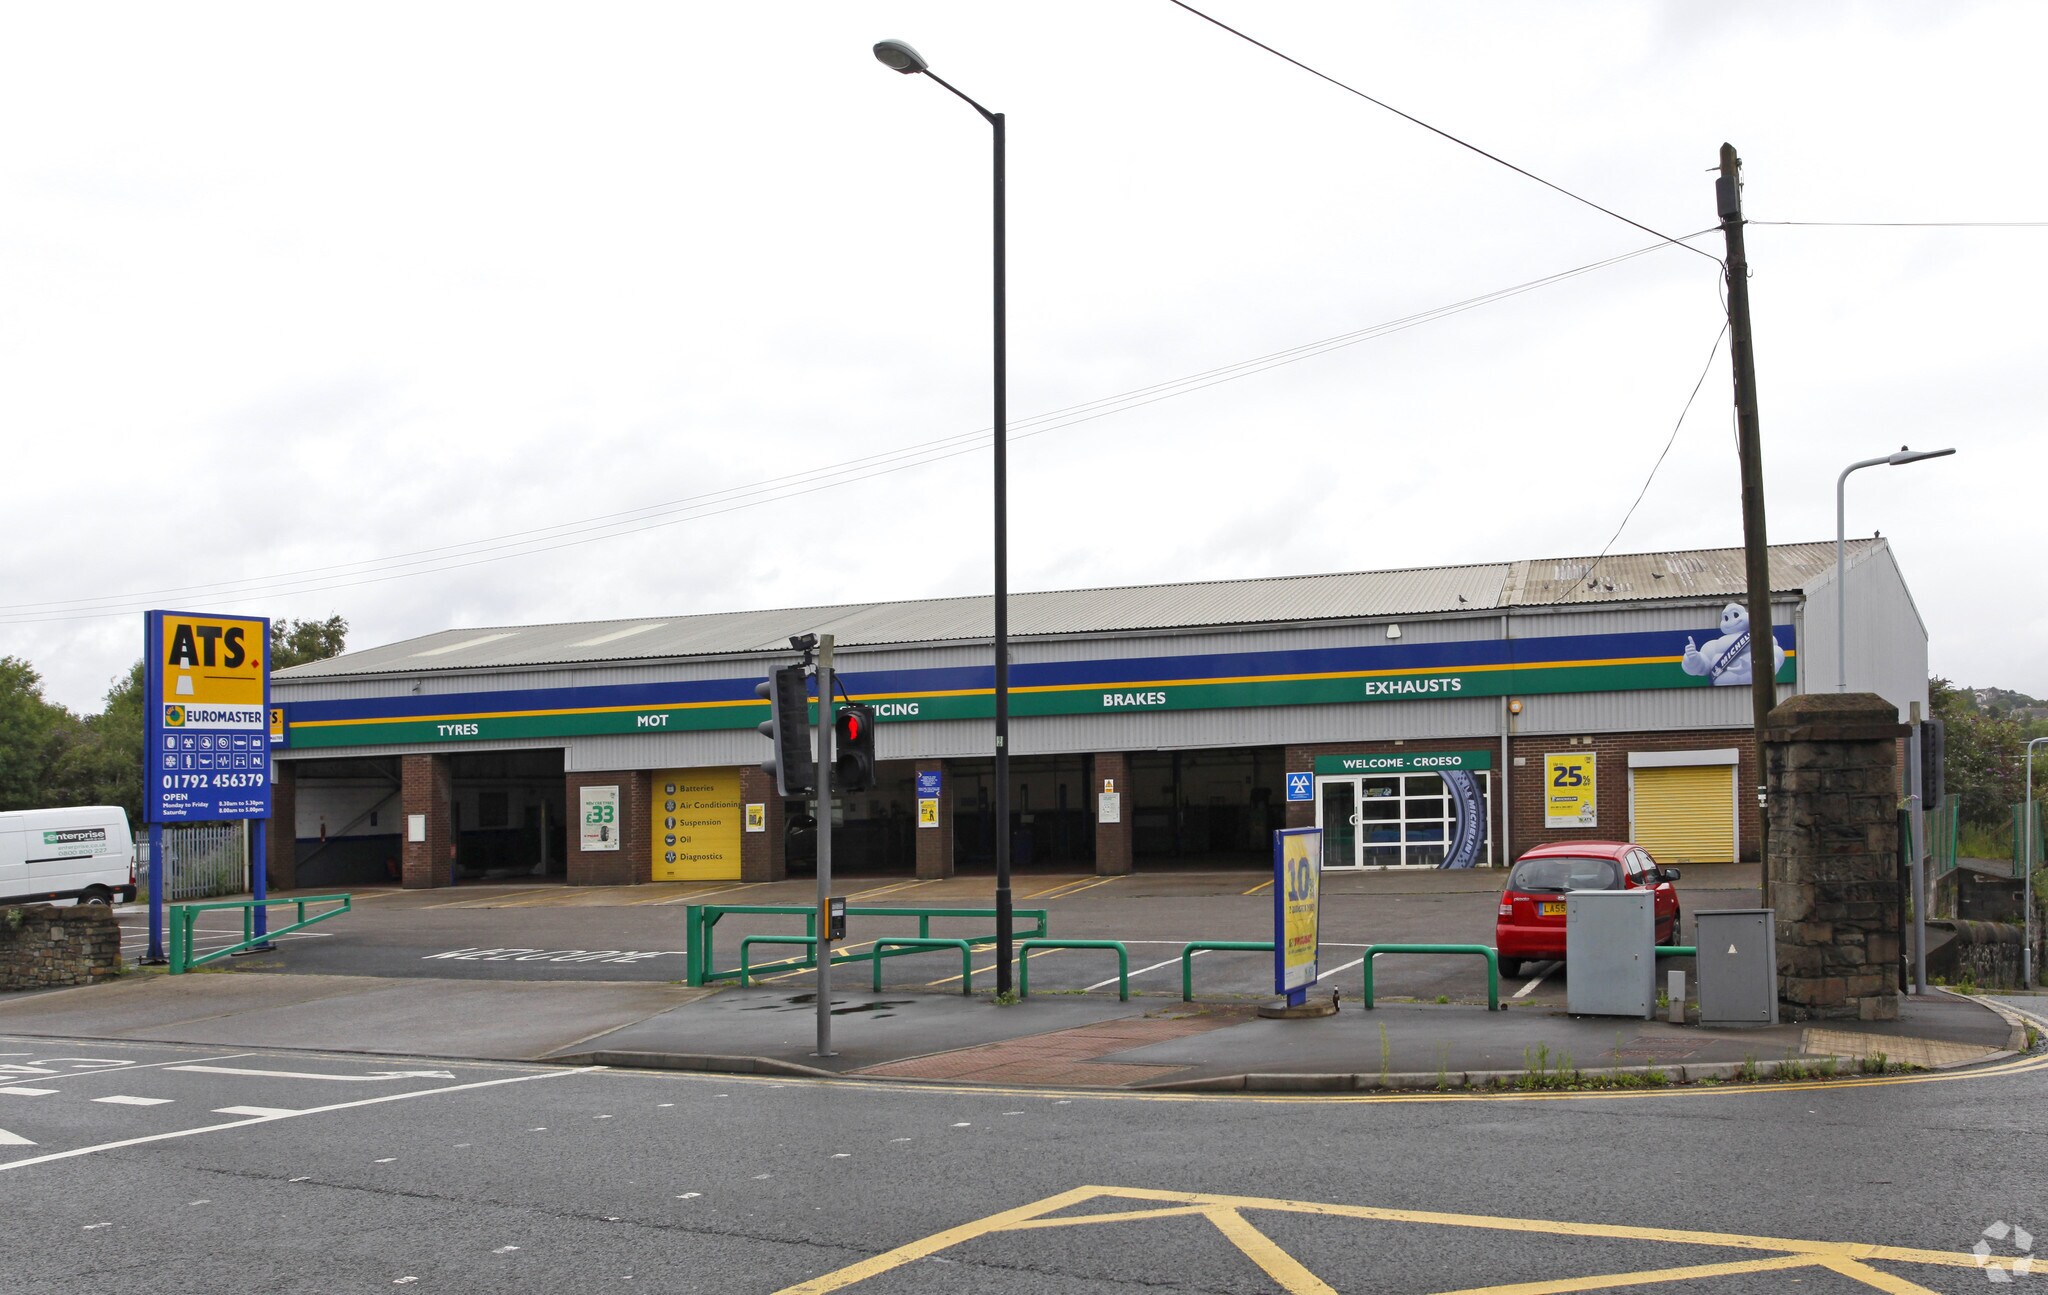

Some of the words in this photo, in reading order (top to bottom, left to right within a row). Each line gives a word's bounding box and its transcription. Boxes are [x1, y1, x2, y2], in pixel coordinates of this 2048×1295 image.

[1720, 632, 1751, 667] MICHEL
[1365, 678, 1462, 695] EXHAUSTS
[1103, 691, 1166, 707] BRAKES
[186, 710, 262, 723] EUROMASTER
[637, 714, 669, 727] MOT
[437, 723, 479, 736] TYRES
[1343, 758, 1403, 768] WELCOME
[1413, 756, 1462, 766] CROESO
[162, 774, 209, 789] 01792
[212, 773, 264, 788] 456379
[1554, 766, 1583, 787] 25
[163, 793, 188, 801] OPEN
[694, 801, 741, 810] Conditioning
[680, 818, 721, 828] Suspension
[1464, 799, 1477, 854] MICHELIN
[45, 831, 105, 841] enterprise
[680, 852, 723, 862] Diagnostics
